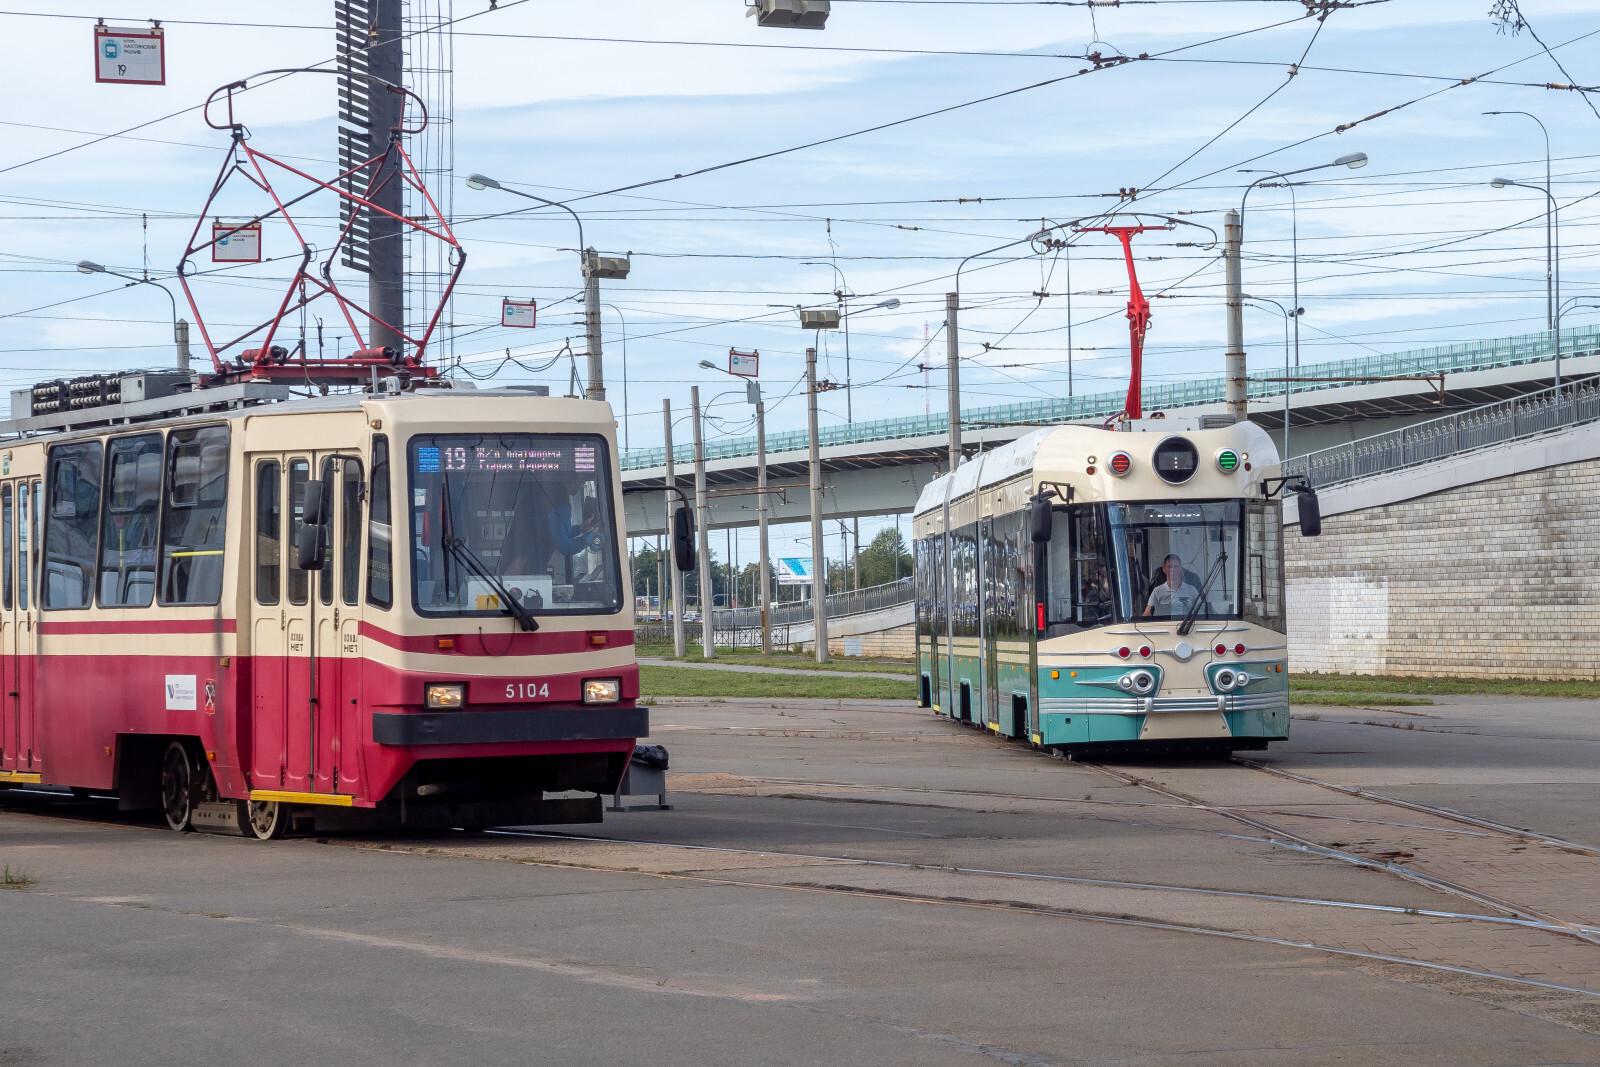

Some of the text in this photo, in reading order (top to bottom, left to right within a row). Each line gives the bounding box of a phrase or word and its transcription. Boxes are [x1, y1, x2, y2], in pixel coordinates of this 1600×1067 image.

[117, 64, 127, 76] 19
[444, 448, 466, 470] 19
[290, 643, 304, 652] НЕТ
[343, 644, 358, 653] НЕТ
[505, 683, 549, 699] 5104
